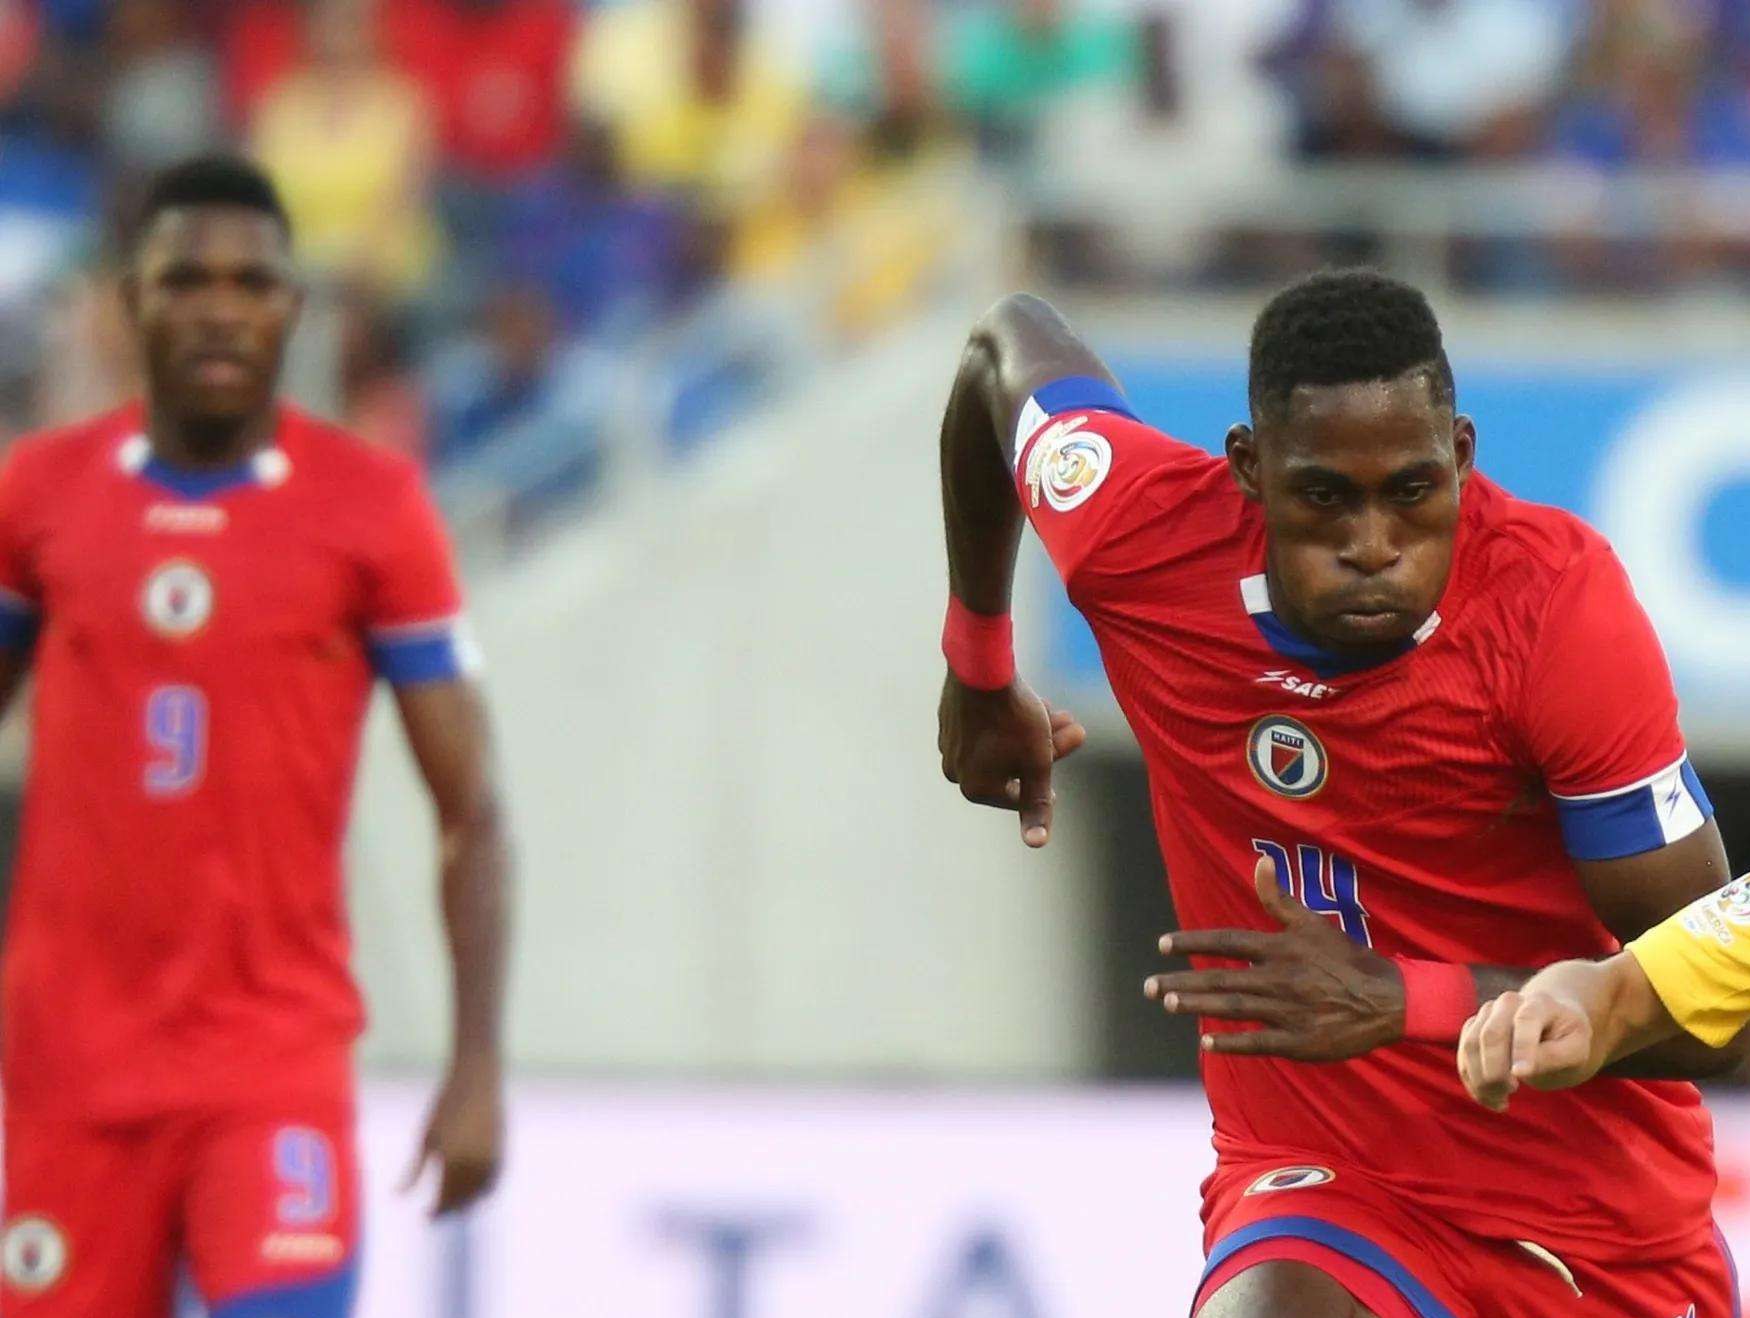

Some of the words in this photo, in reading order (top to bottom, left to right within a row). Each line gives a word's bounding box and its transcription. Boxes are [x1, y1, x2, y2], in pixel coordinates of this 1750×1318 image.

[143, 686, 207, 795] 9
[1250, 838, 1373, 950] 14
[273, 1124, 338, 1226] 9
